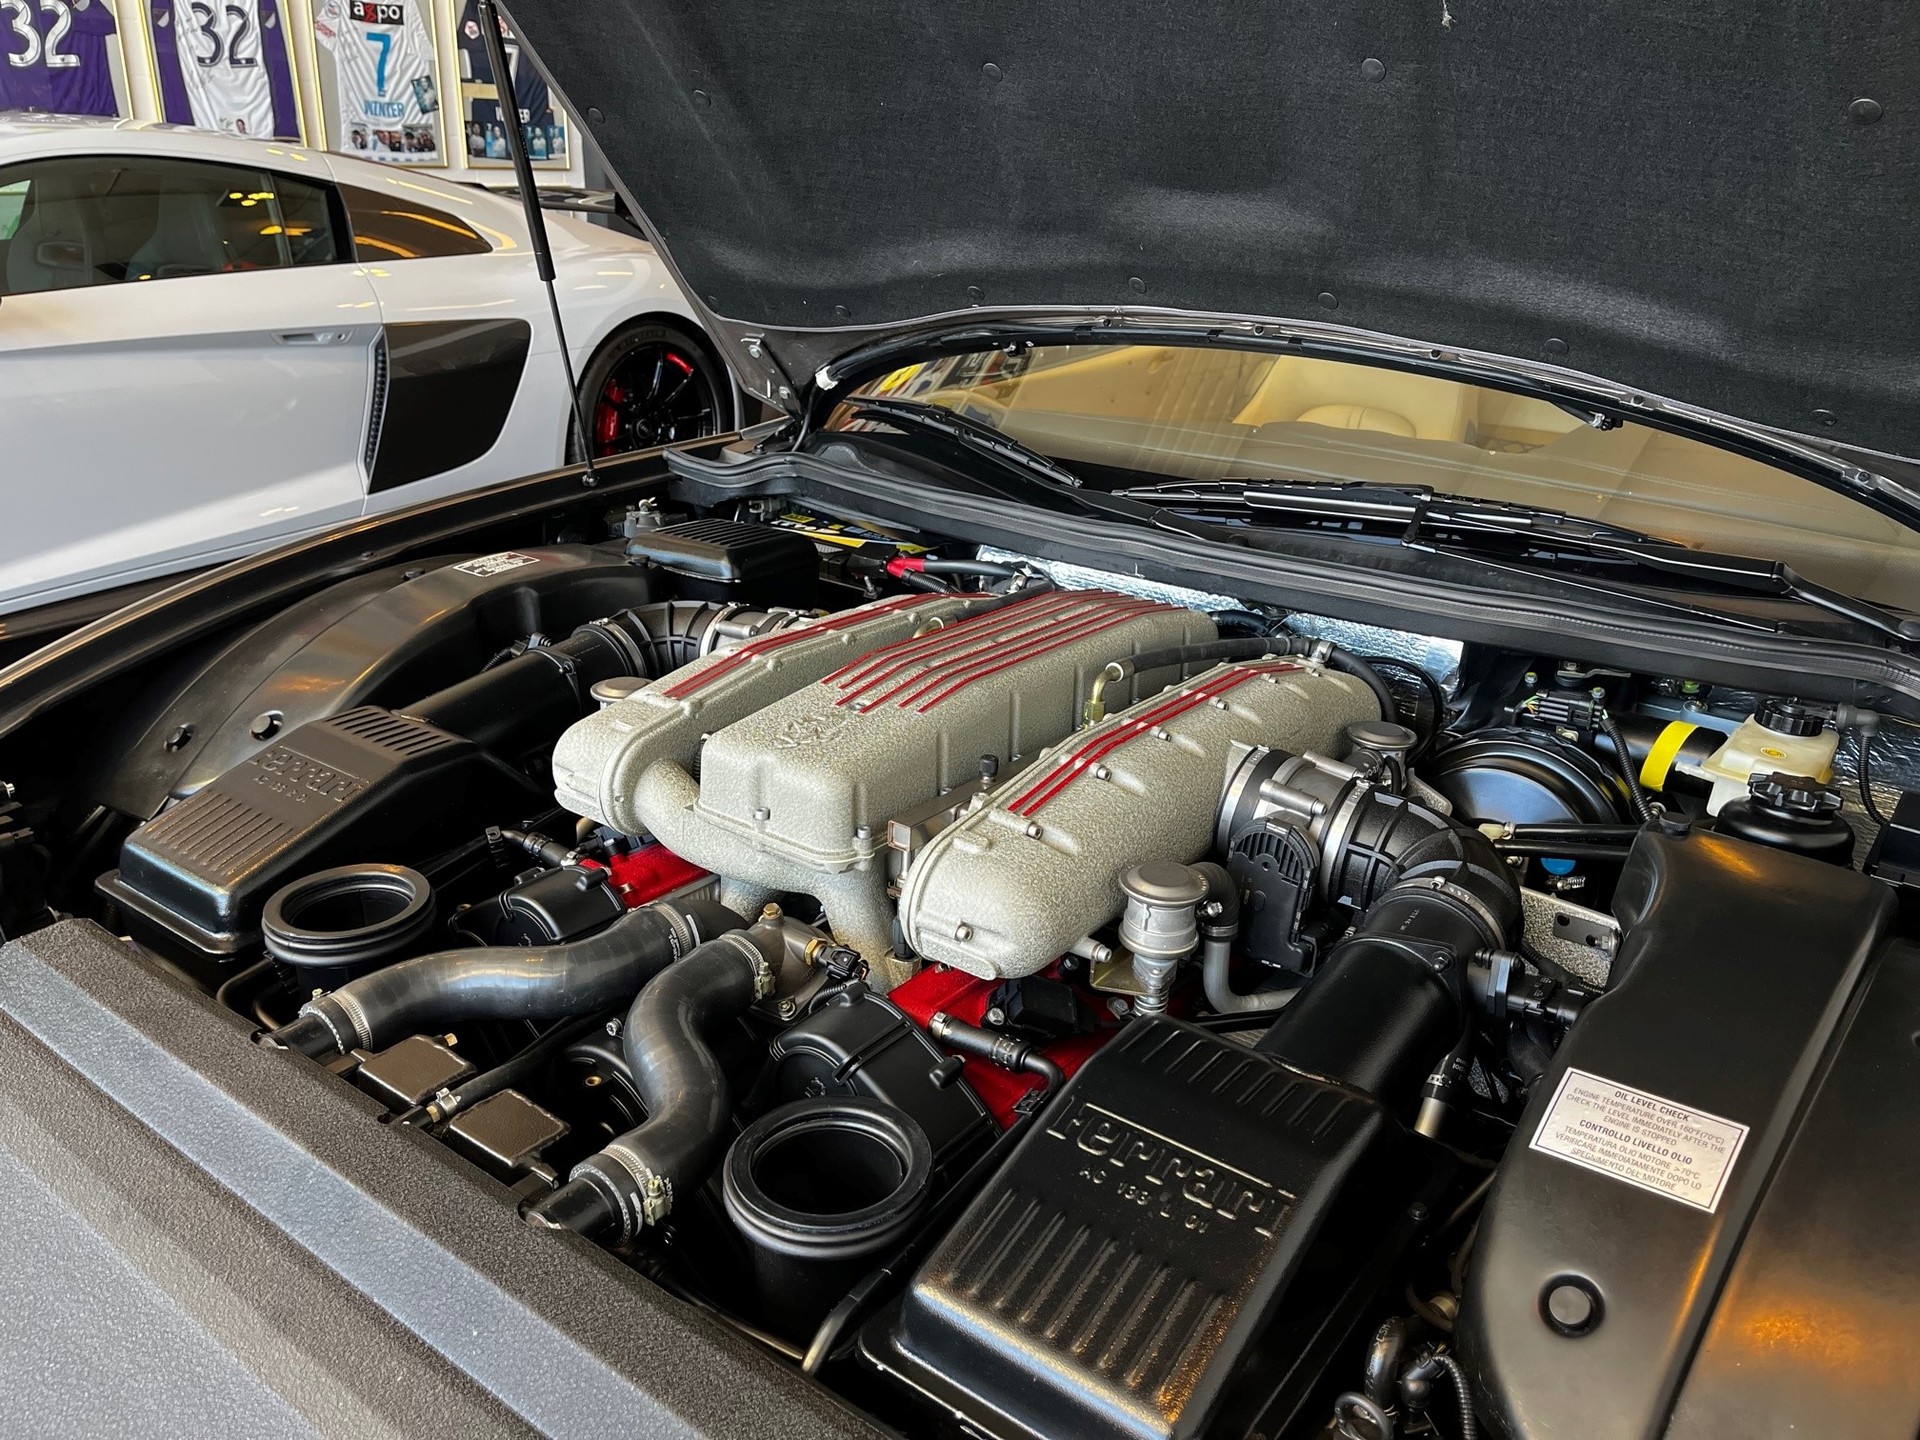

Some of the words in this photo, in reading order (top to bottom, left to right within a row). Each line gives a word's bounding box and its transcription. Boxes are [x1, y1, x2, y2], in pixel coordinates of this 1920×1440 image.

[0, 0, 81, 68] 32
[191, 2, 258, 68] 32
[366, 32, 391, 97] 7
[1565, 1093, 1591, 1106] CHECK
[1592, 1102, 1606, 1112] THE
[1607, 1108, 1630, 1120] LEVEL
[1631, 1116, 1681, 1138] IMMEDIATELY
[1682, 1134, 1709, 1148] AFTER
[1709, 1143, 1725, 1154] THE
[1573, 1087, 1600, 1101] ENGINE
[1601, 1097, 1655, 1120] TEMPERATURE
[1655, 1116, 1678, 1128] OVER
[1614, 1090, 1629, 1100] OIL
[1630, 1096, 1658, 1110] LEVEL
[1658, 1105, 1690, 1121] CHECK
[1563, 1125, 1618, 1149] TEMPERATURA
[1618, 1145, 1637, 1156] OLIO
[1637, 1152, 1671, 1169] MOTORE
[1578, 1119, 1631, 1142] CONTROLLO
[1631, 1138, 1669, 1156] LIVELLO
[1670, 1151, 1692, 1164] OLIO
[1602, 1115, 1631, 1129] ENGINE
[1640, 1128, 1677, 1146] STOPPED
[1554, 1132, 1597, 1152] VERIFICARE
[1597, 1147, 1665, 1176] IMMEDIATAMENTE
[1666, 1172, 1689, 1185] DOPO
[1690, 1181, 1702, 1190] LO
[1570, 1147, 1625, 1171] SPEGNIMENTO
[1625, 1167, 1641, 1177] DEL
[1641, 1173, 1676, 1190] MOTORE
